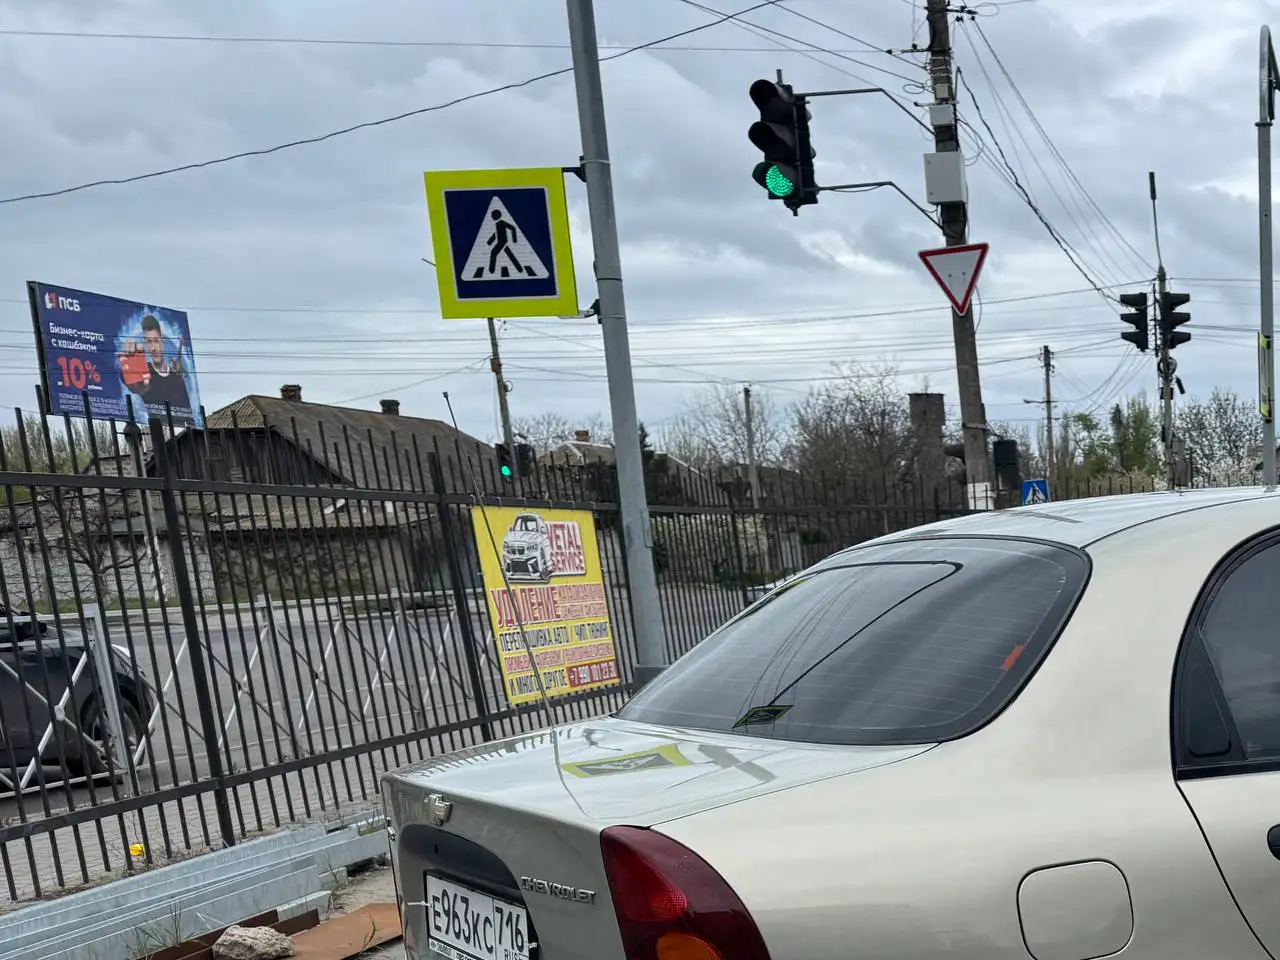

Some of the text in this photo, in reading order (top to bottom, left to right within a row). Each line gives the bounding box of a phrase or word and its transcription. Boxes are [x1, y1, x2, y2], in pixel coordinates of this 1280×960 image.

[58, 296, 81, 312] ПСБ
[49, 322, 104, 342] Бизнес-карта
[56, 356, 101, 389] 10%
[521, 876, 597, 905] CHEVROLET
[432, 888, 524, 954] Е963КС 716
